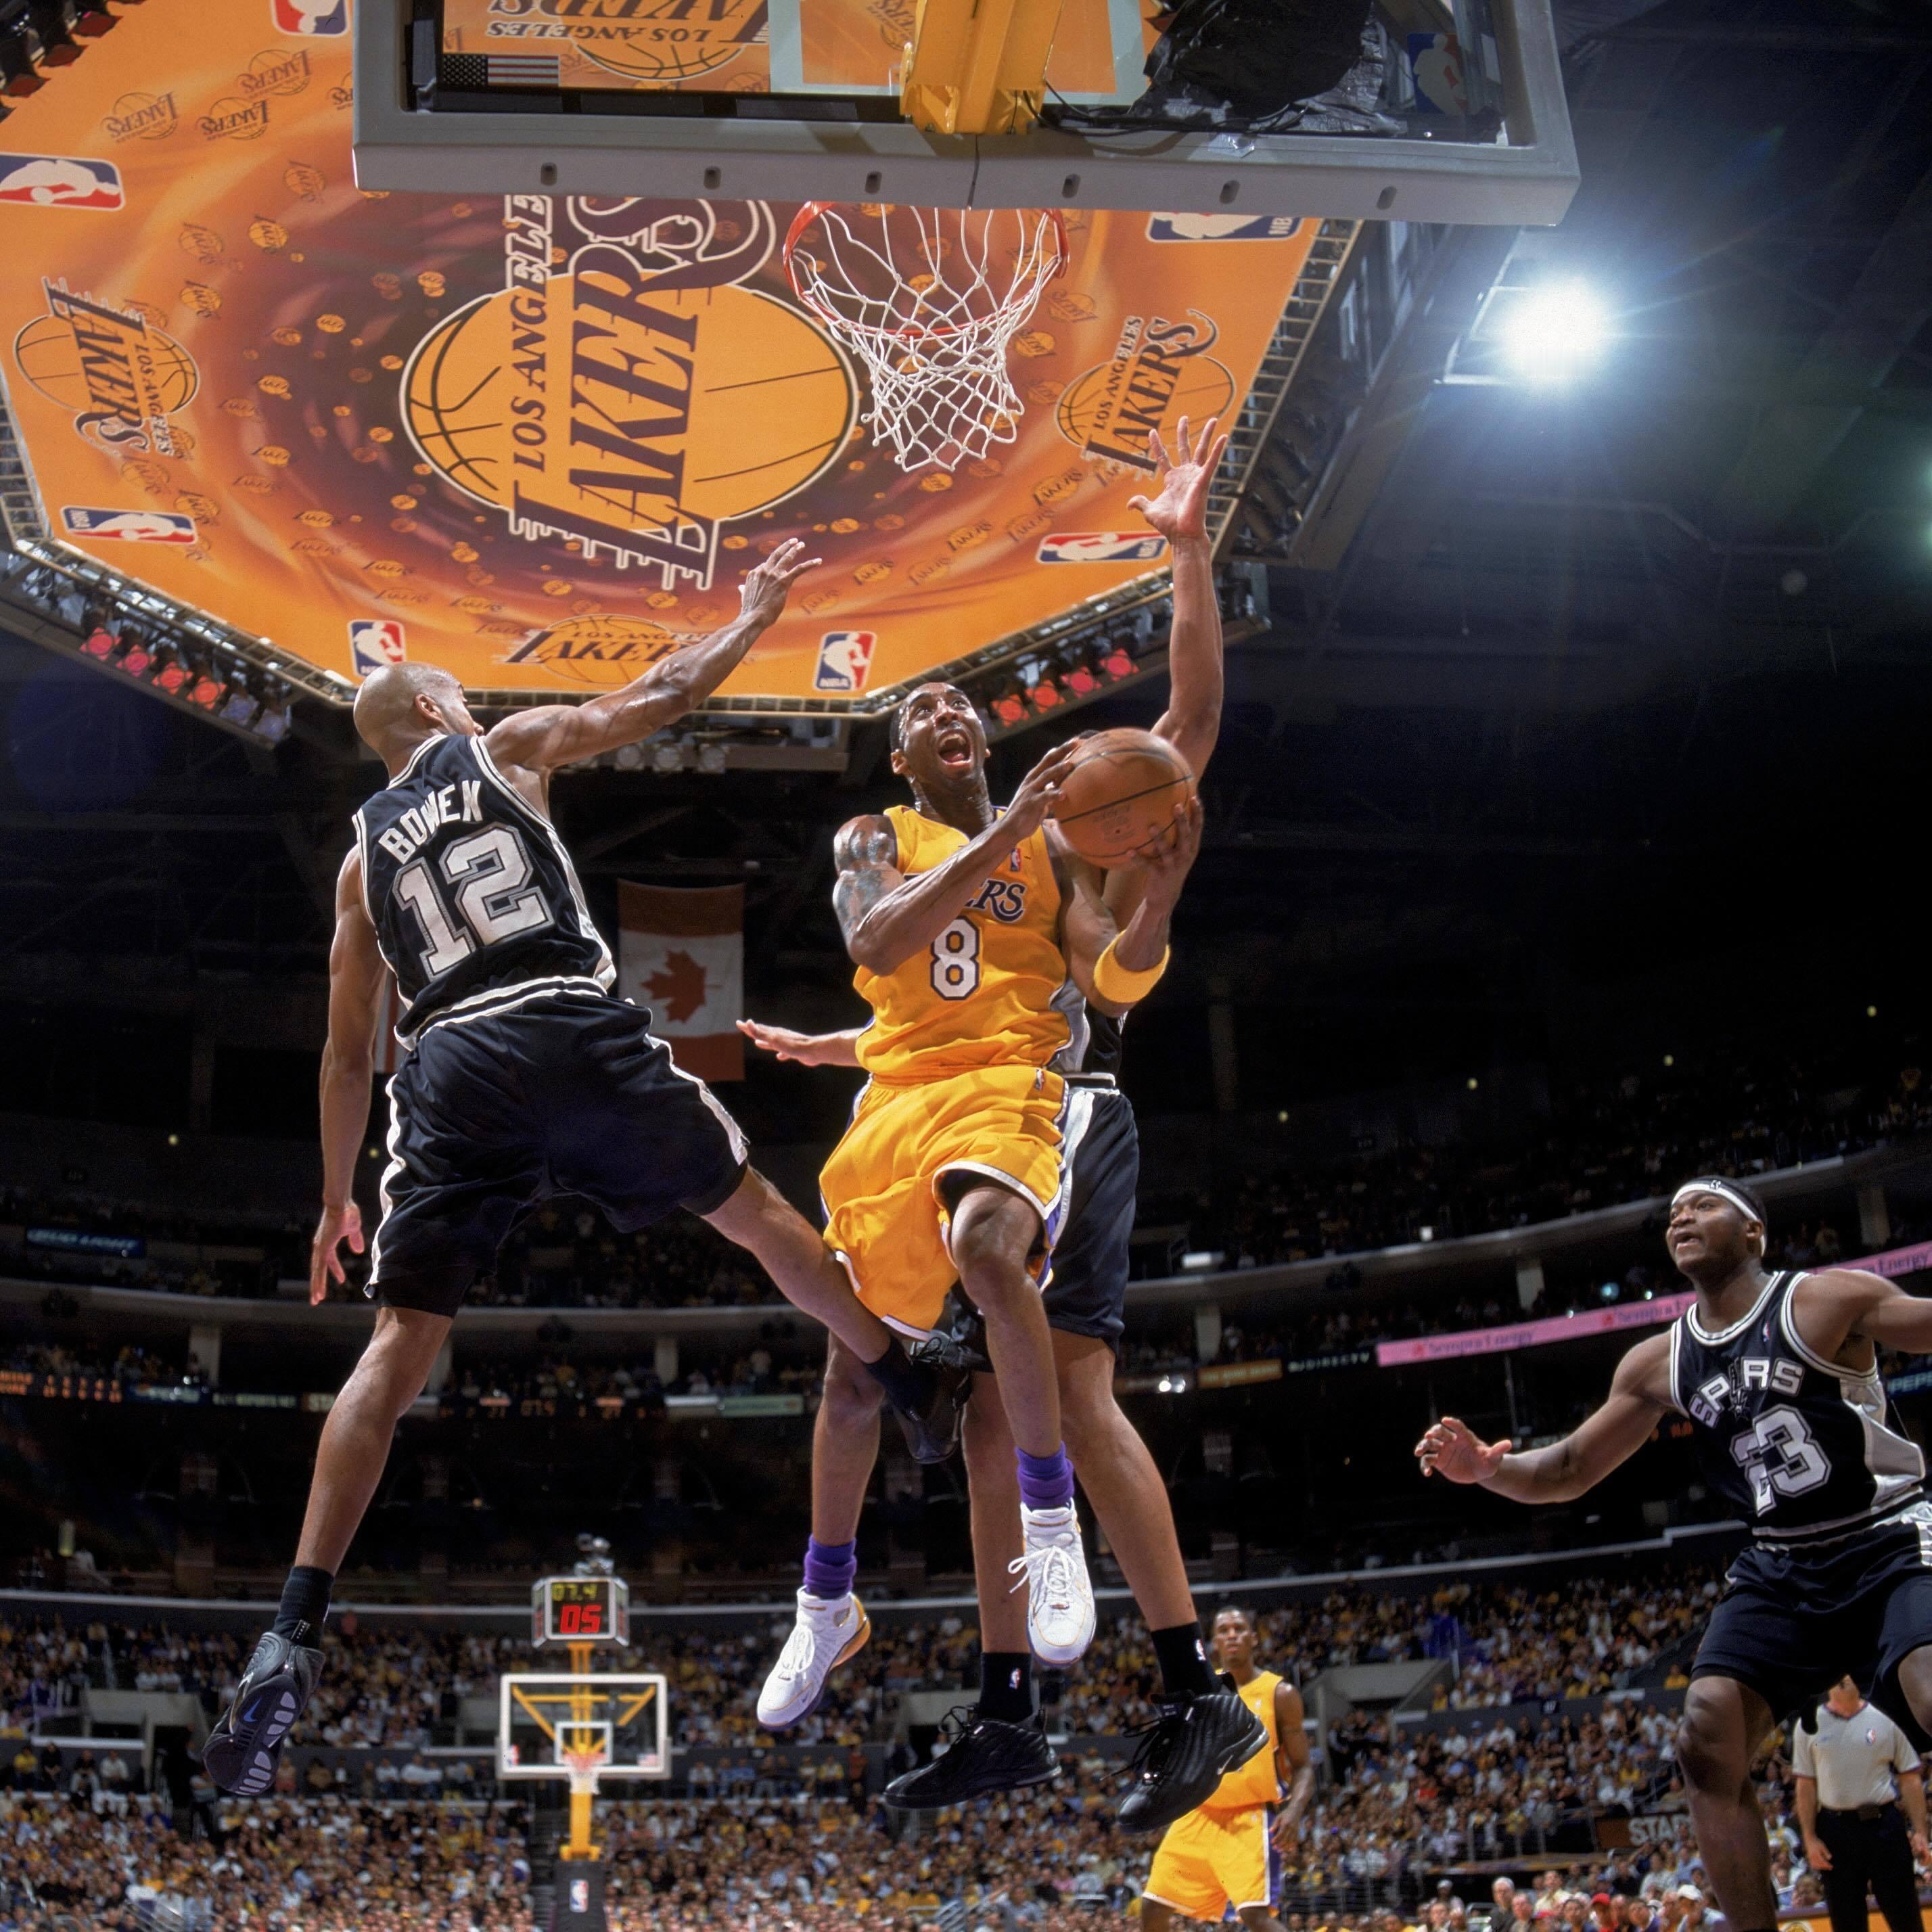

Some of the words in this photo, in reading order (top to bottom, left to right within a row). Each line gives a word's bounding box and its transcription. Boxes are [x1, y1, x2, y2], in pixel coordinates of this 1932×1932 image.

[486, 20, 646, 42] ANGELES
[648, 27, 712, 43] LOS
[506, 195, 552, 392] ANGELE
[41, 277, 150, 456] LAKERS
[1081, 308, 1220, 481] LAKERS
[1092, 400, 1113, 430] LOS
[1108, 316, 1145, 399] ANGELES
[511, 395, 547, 472] LOS
[505, 629, 676, 664] LAKER
[620, 632, 712, 641] ANGELE
[377, 779, 483, 865] BOWEN
[392, 821, 555, 983] 12
[929, 915, 982, 1001] 8
[559, 1604, 602, 1634] 05
